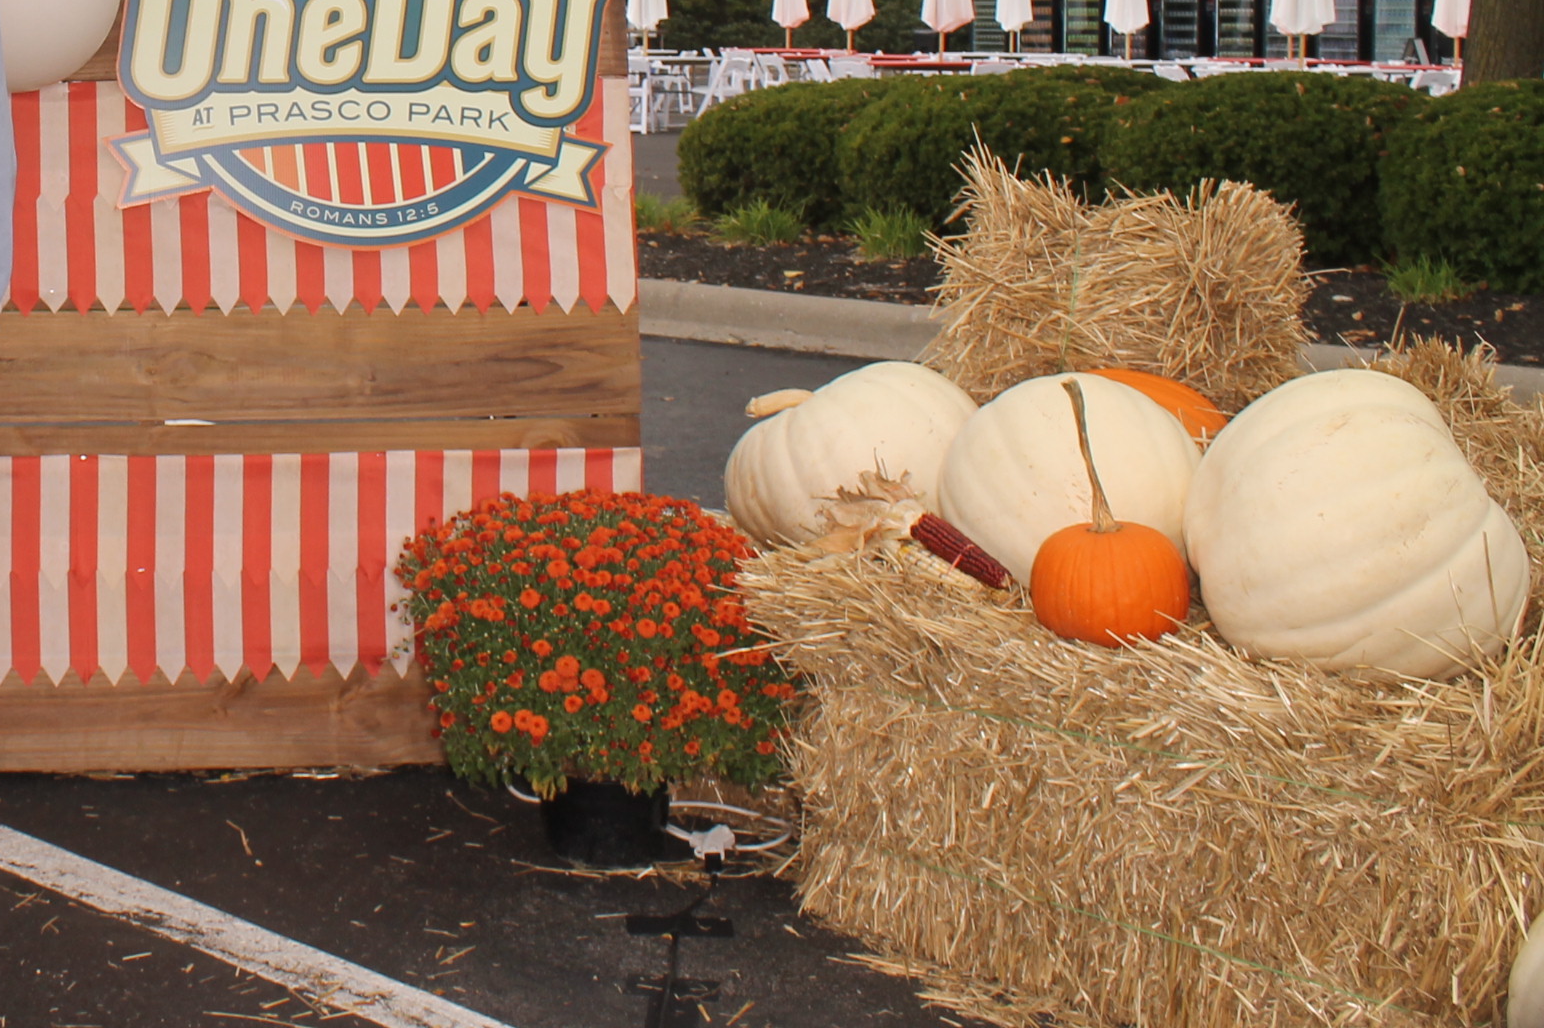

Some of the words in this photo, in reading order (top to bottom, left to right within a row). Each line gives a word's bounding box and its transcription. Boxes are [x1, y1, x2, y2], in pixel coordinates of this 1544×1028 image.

[192, 106, 214, 127] AT
[228, 100, 392, 126] PRASCO
[407, 102, 511, 132] PARK
[289, 199, 389, 226] ROMANS
[396, 201, 441, 224] 12:5
